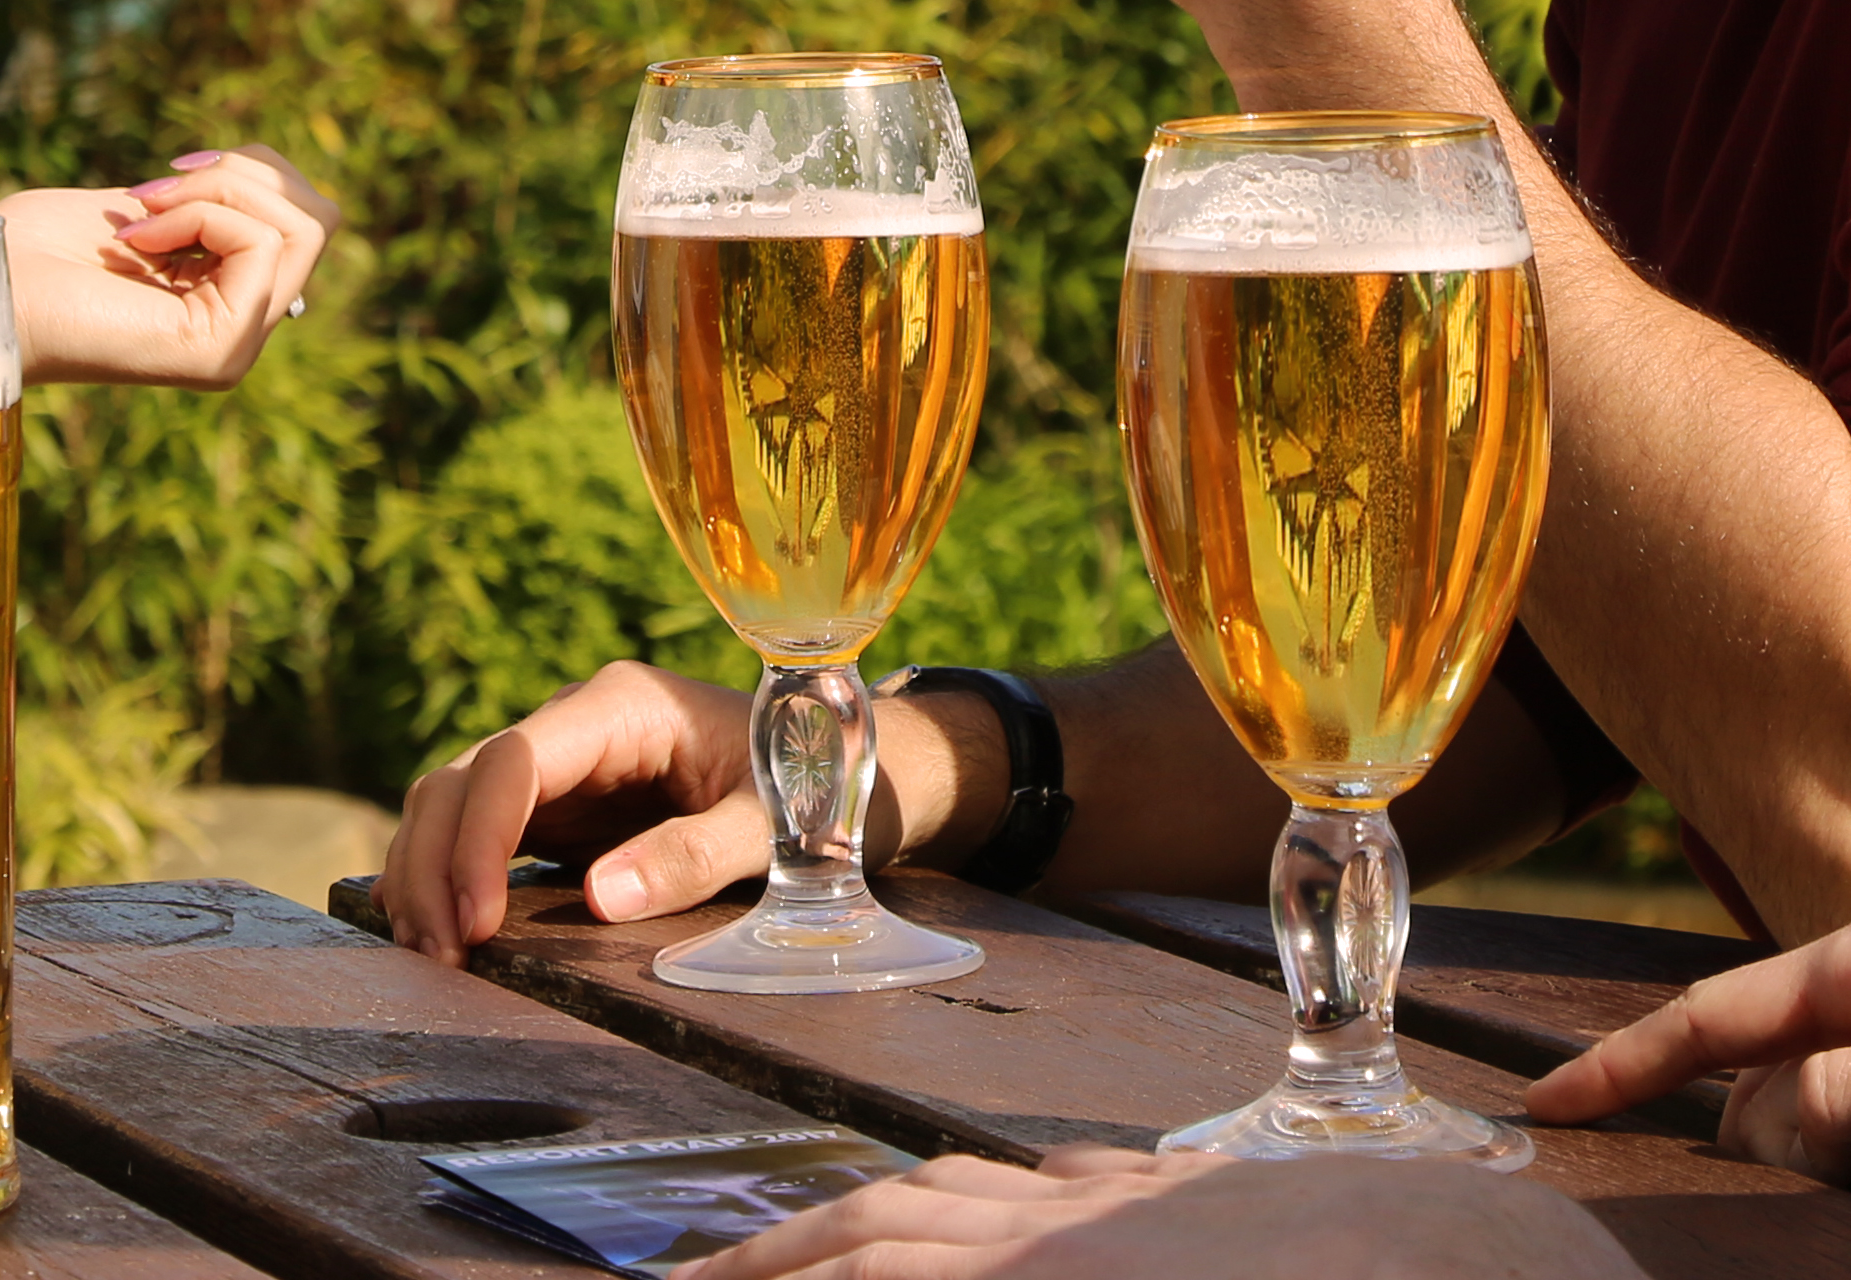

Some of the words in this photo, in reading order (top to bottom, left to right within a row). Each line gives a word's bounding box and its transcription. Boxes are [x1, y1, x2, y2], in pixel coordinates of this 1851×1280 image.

[446, 1144, 630, 1169] RESORT
[637, 1136, 747, 1153] MAP
[752, 1129, 839, 1145] 2017
